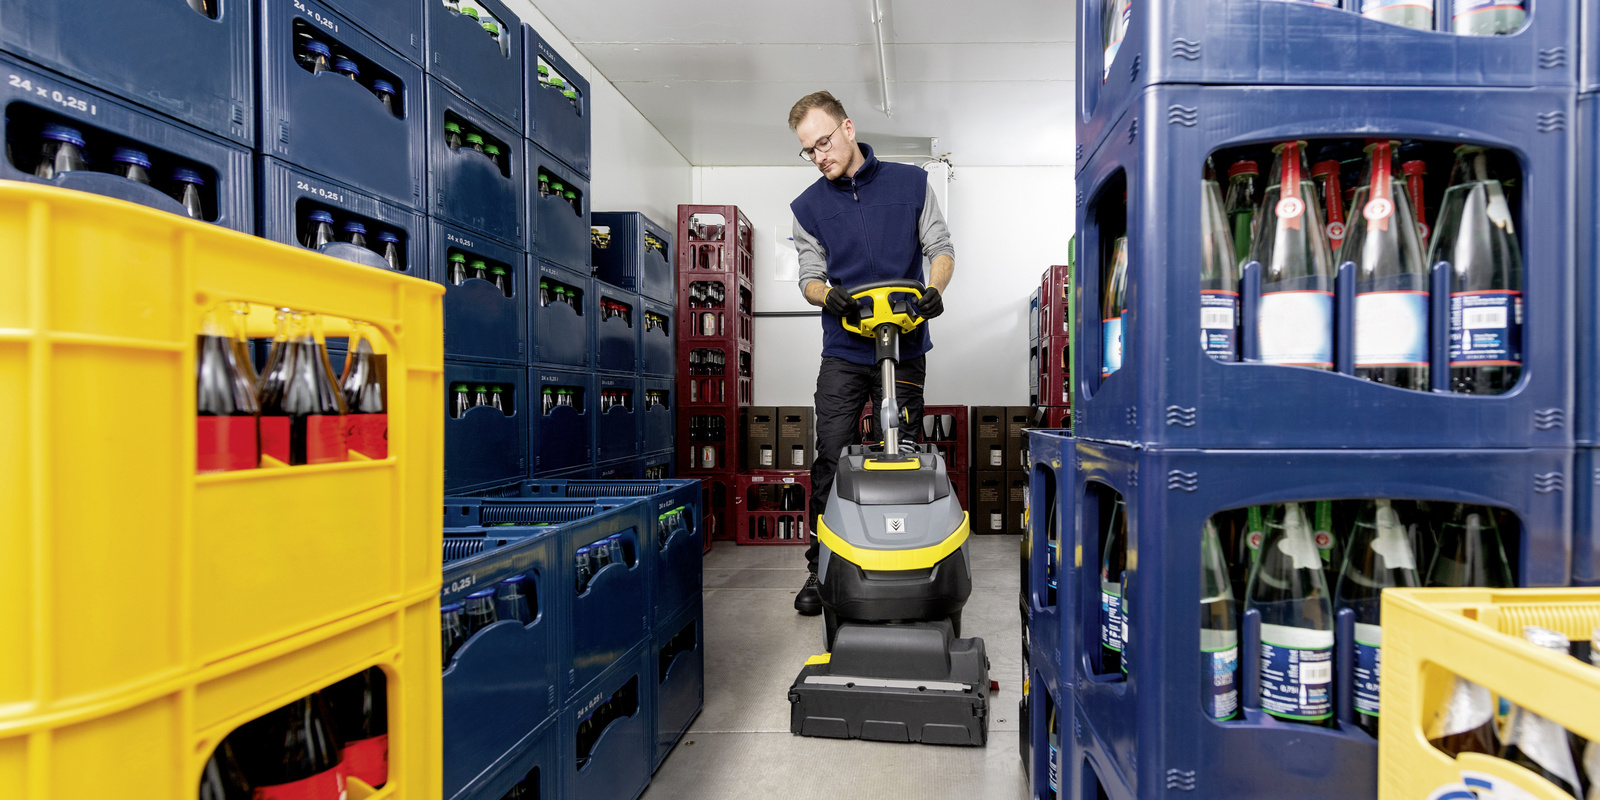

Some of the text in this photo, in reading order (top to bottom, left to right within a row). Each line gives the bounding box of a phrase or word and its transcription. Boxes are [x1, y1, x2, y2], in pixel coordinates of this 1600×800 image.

[294, 0, 305, 12] 24
[307, 9, 314, 18] x
[315, 13, 334, 29] 0,25
[8, 74, 32, 92] 24
[36, 87, 48, 98] x
[52, 91, 87, 112] 0,25
[297, 181, 309, 191] 24
[319, 188, 338, 201] 0,25
[459, 238, 470, 247] 0,25
[443, 587, 450, 596] x
[452, 577, 471, 592] 0,25
[577, 708, 584, 719] 24
[588, 694, 600, 708] 0,25
